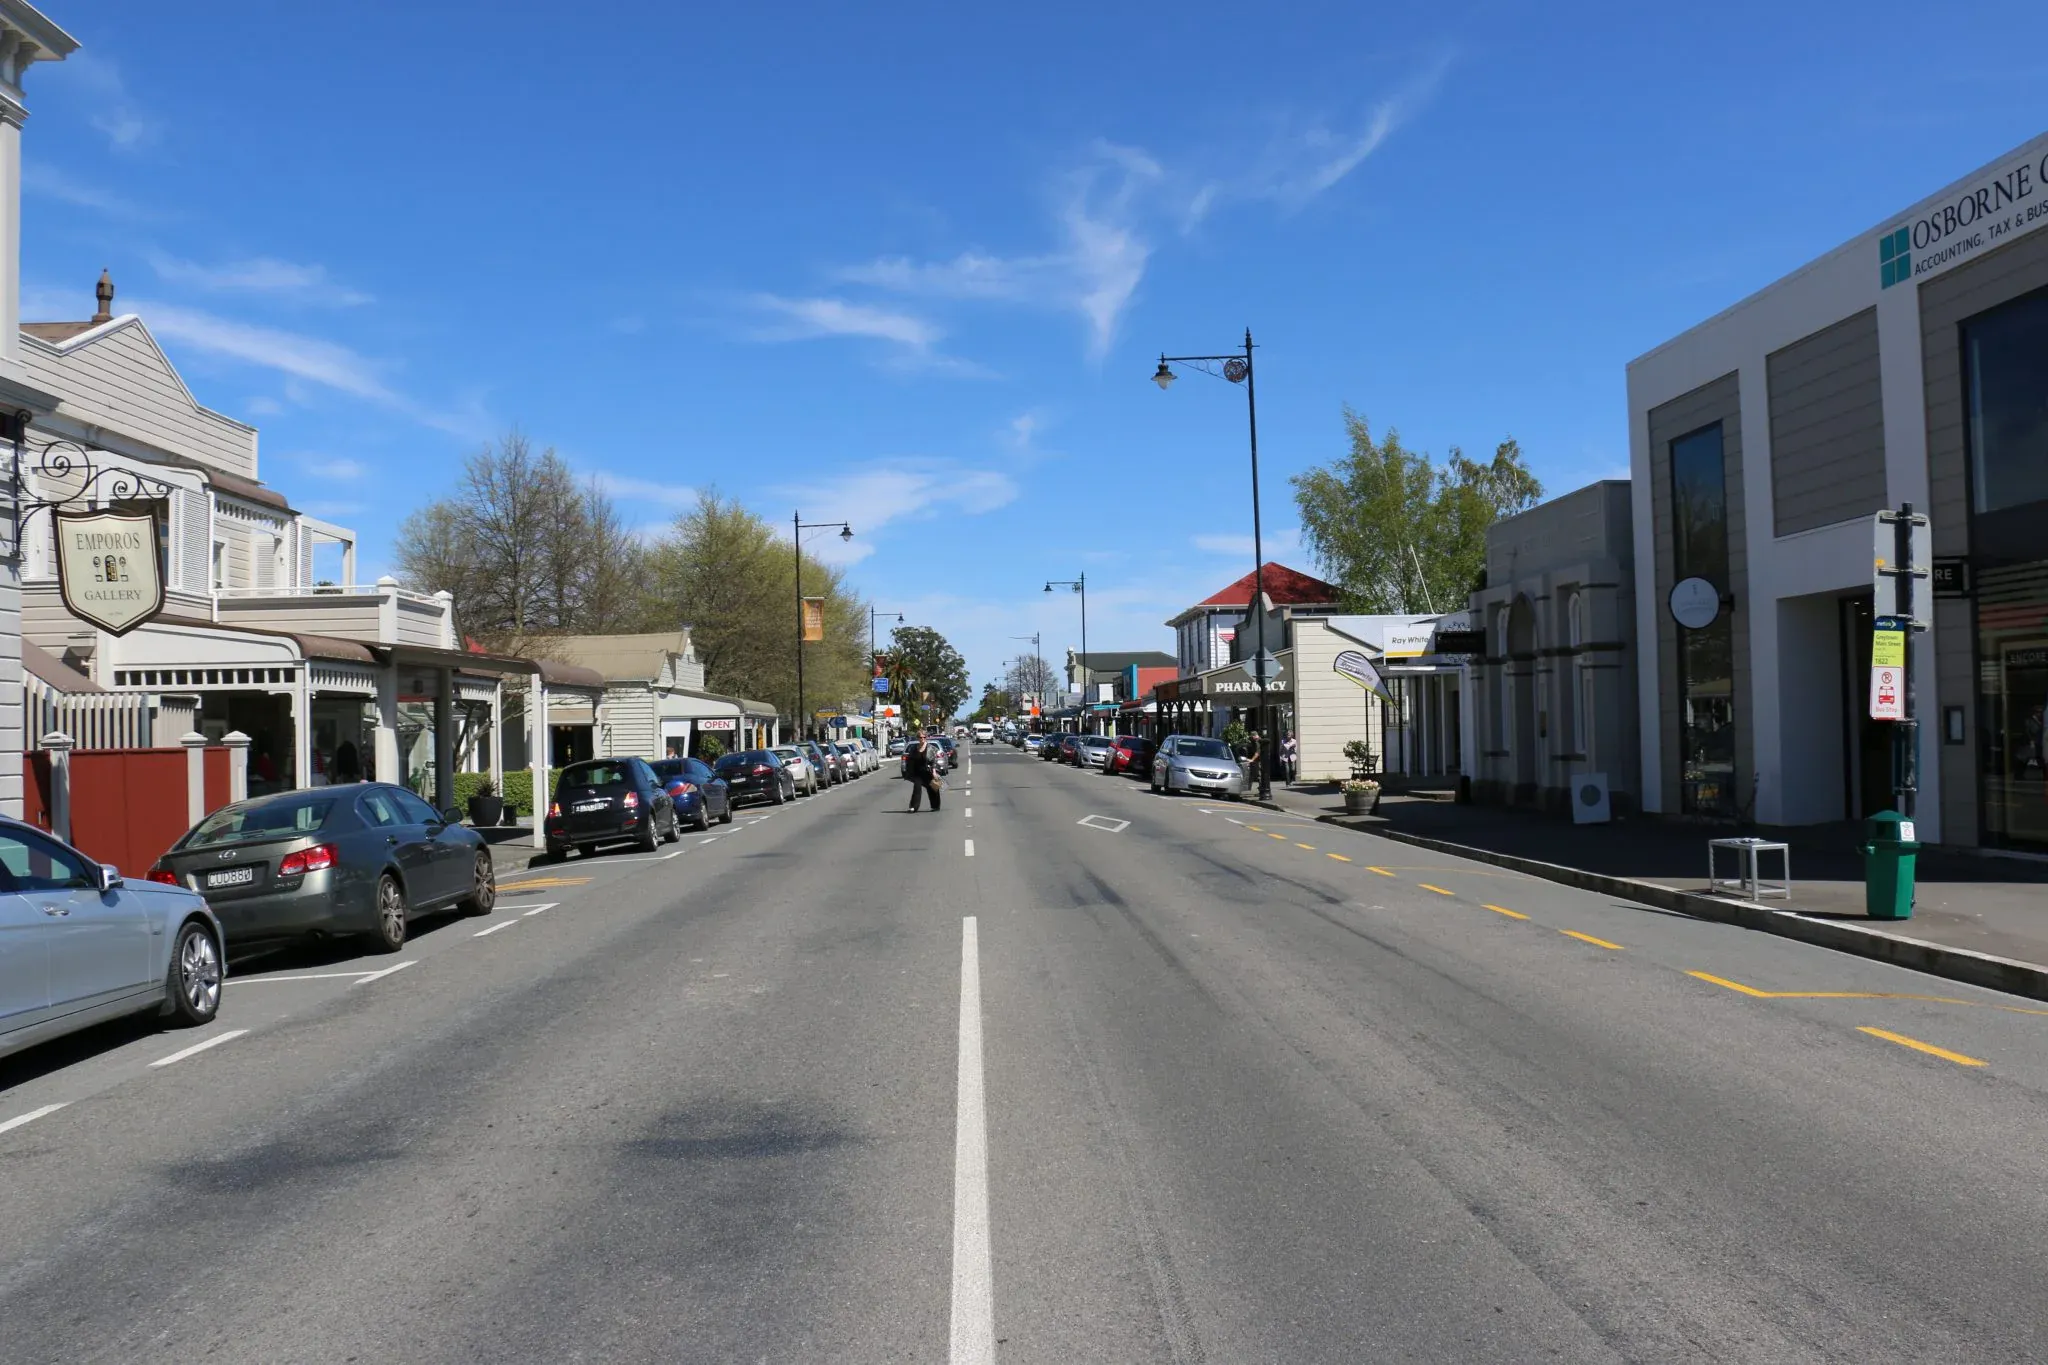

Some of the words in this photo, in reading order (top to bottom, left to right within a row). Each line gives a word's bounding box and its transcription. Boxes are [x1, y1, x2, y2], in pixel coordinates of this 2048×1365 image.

[1913, 164, 2032, 249] OSBORNE
[1914, 233, 1985, 276] ACCOUNTING,
[1988, 217, 2011, 240] TAX
[2015, 213, 2025, 228] &
[76, 532, 140, 550] EMPOROS
[84, 589, 142, 601] GALLERY
[1391, 636, 1407, 645] Ray
[1408, 635, 1430, 643] White
[704, 720, 731, 729] OPEN
